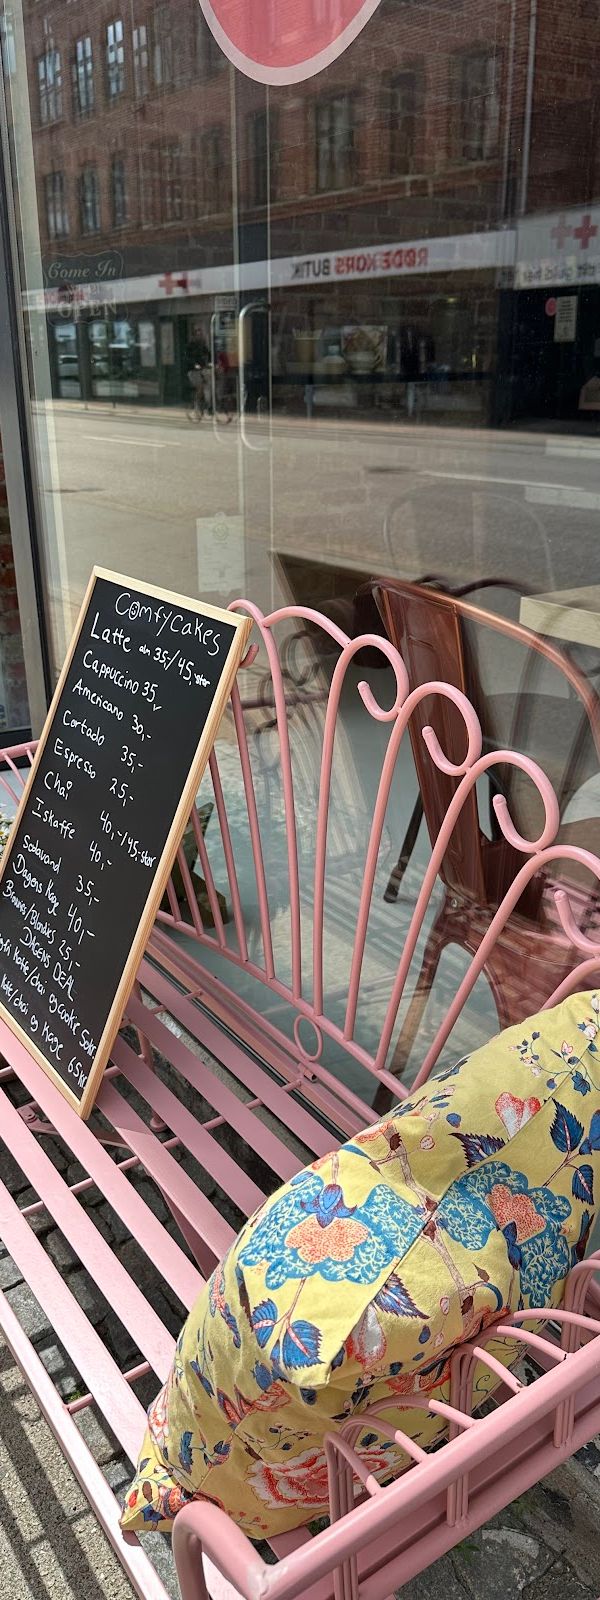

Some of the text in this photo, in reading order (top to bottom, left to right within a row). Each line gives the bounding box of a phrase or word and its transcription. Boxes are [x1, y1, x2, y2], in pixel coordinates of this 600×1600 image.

[48, 260, 116, 279] Come In
[90, 612, 131, 653] Latte
[82, 650, 139, 694] Cappuccino
[63, 709, 144, 773] Cortado 35,-
[72, 678, 152, 741] Americano 30,-
[44, 771, 73, 800] Chai
[53, 738, 134, 807] Espresso 25,-
[31, 797, 112, 870] Iskaffe 40,-
[13, 853, 43, 893] Dagens
[67, 903, 96, 945] 40,-
[23, 834, 100, 906] Sodavand 35,-
[58, 939, 81, 972] 25,-
